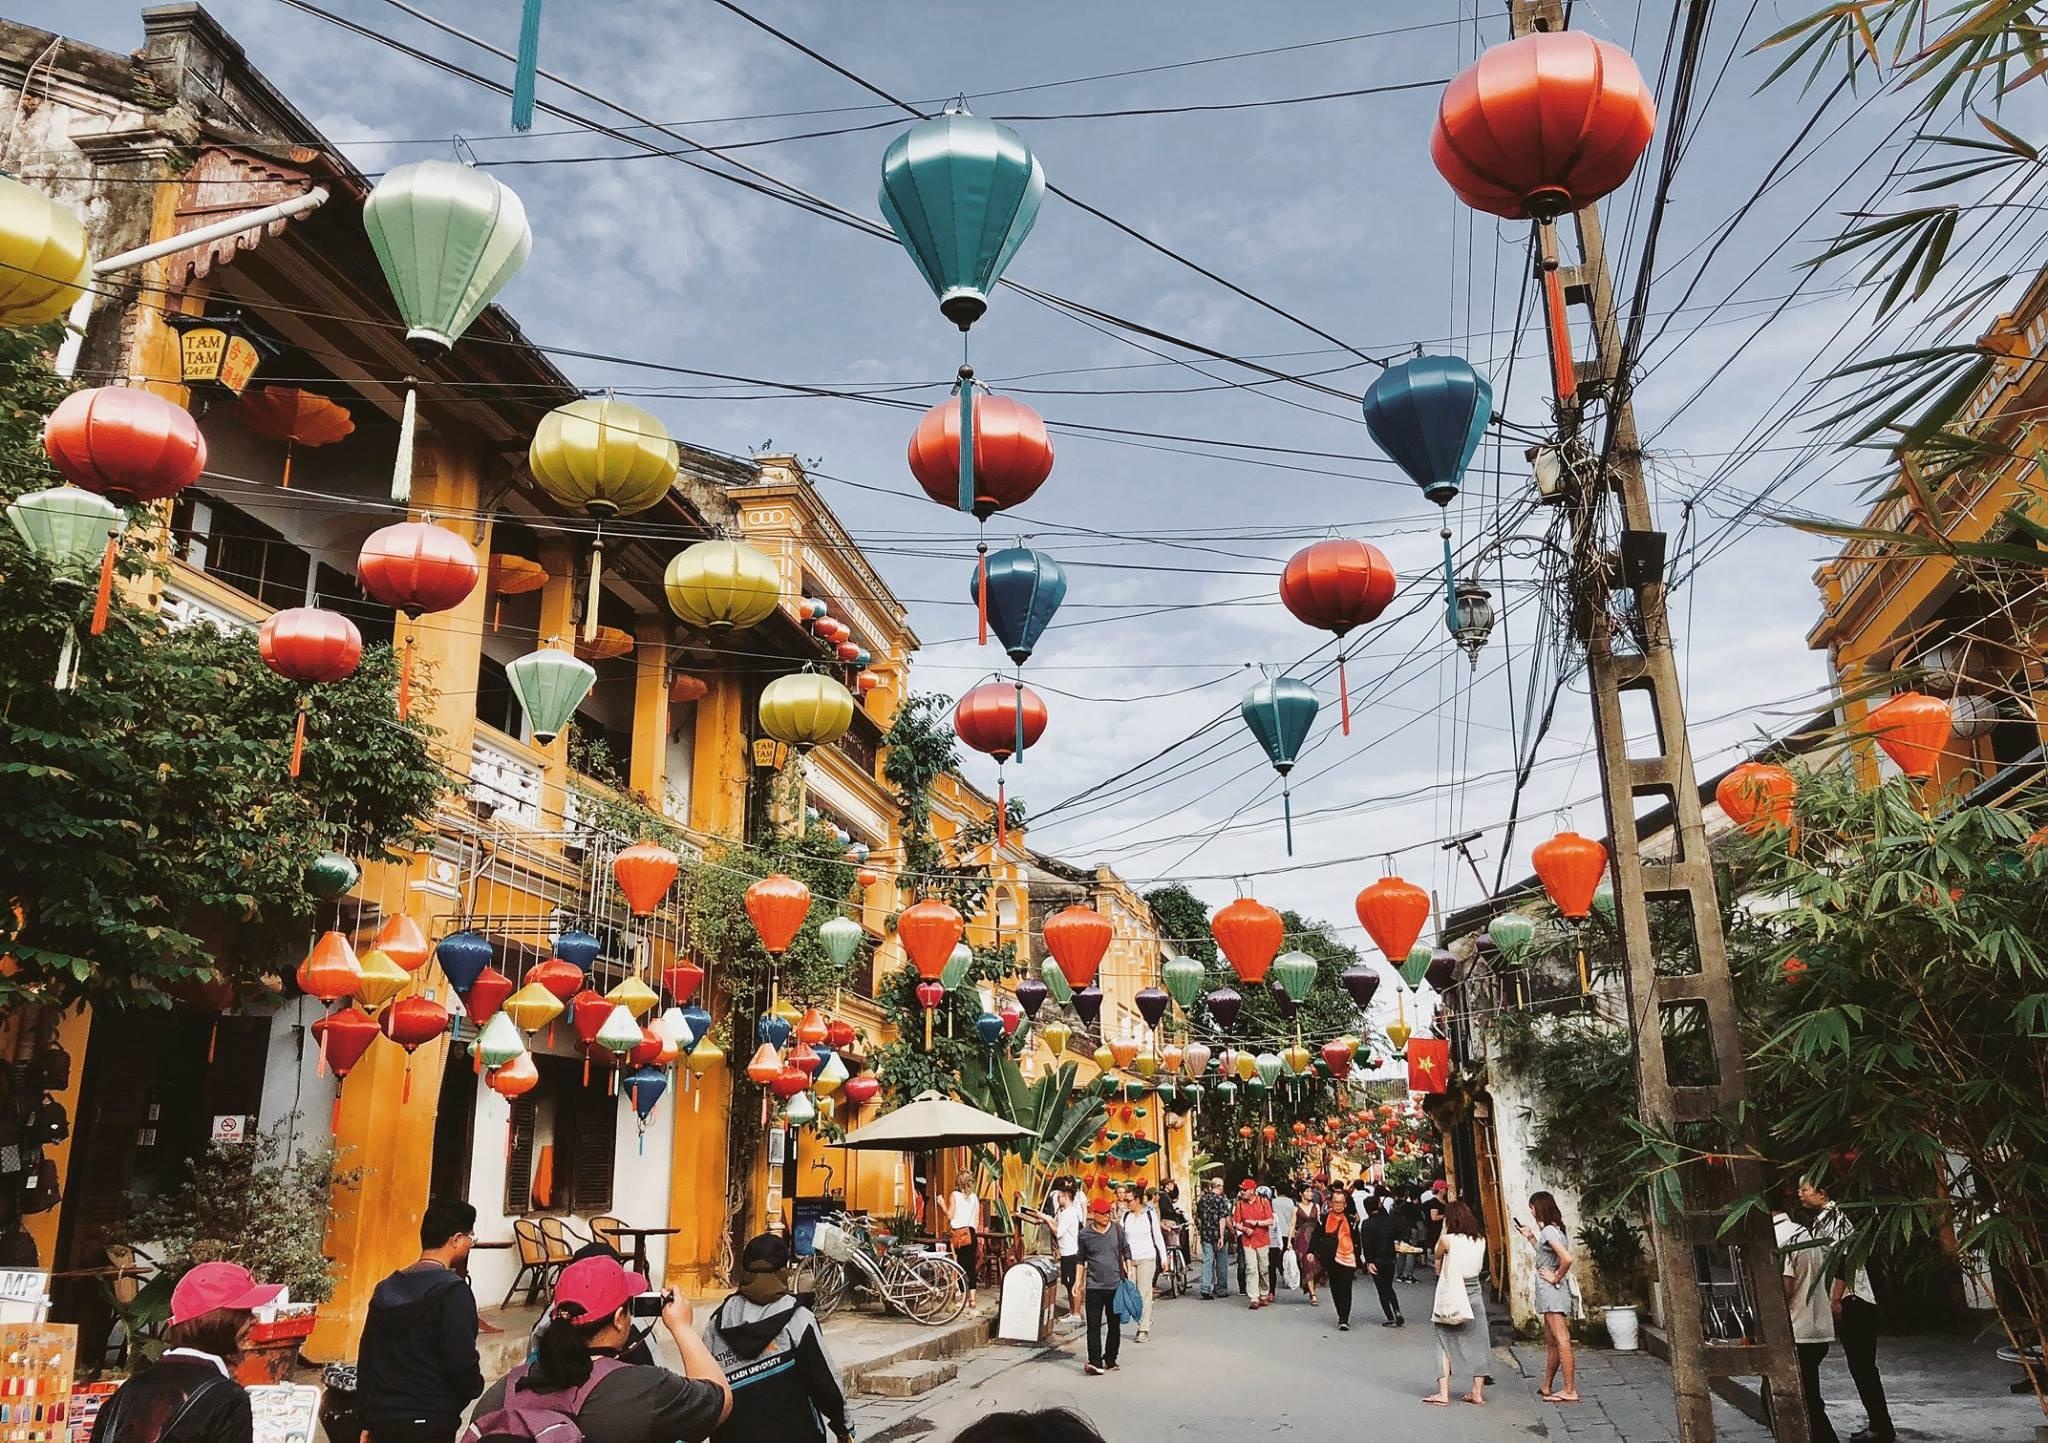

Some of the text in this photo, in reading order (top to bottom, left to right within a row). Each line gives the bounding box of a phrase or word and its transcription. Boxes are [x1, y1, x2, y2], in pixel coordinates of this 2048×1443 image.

[185, 335, 221, 349] TAM
[185, 351, 217, 364] TAM
[184, 365, 214, 375] CAFE
[755, 750, 773, 758] TAM
[748, 1357, 781, 1374] UNIVERSITY
